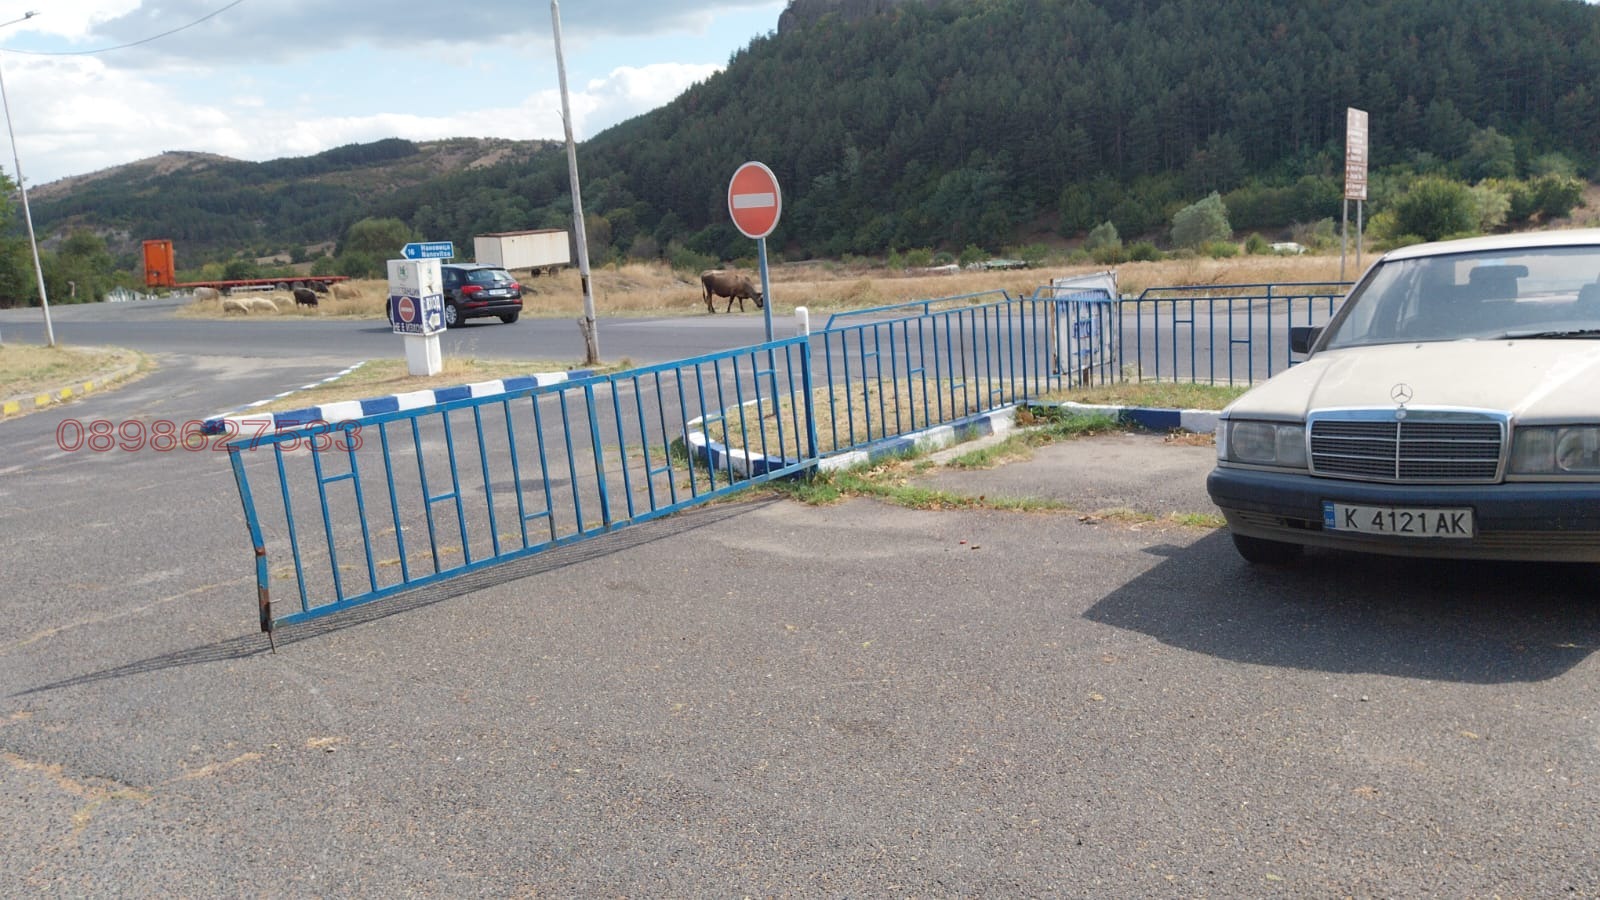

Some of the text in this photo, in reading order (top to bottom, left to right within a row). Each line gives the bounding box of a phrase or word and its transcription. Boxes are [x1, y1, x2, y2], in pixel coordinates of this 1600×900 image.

[1345, 508, 1467, 534] K 4121 AK
